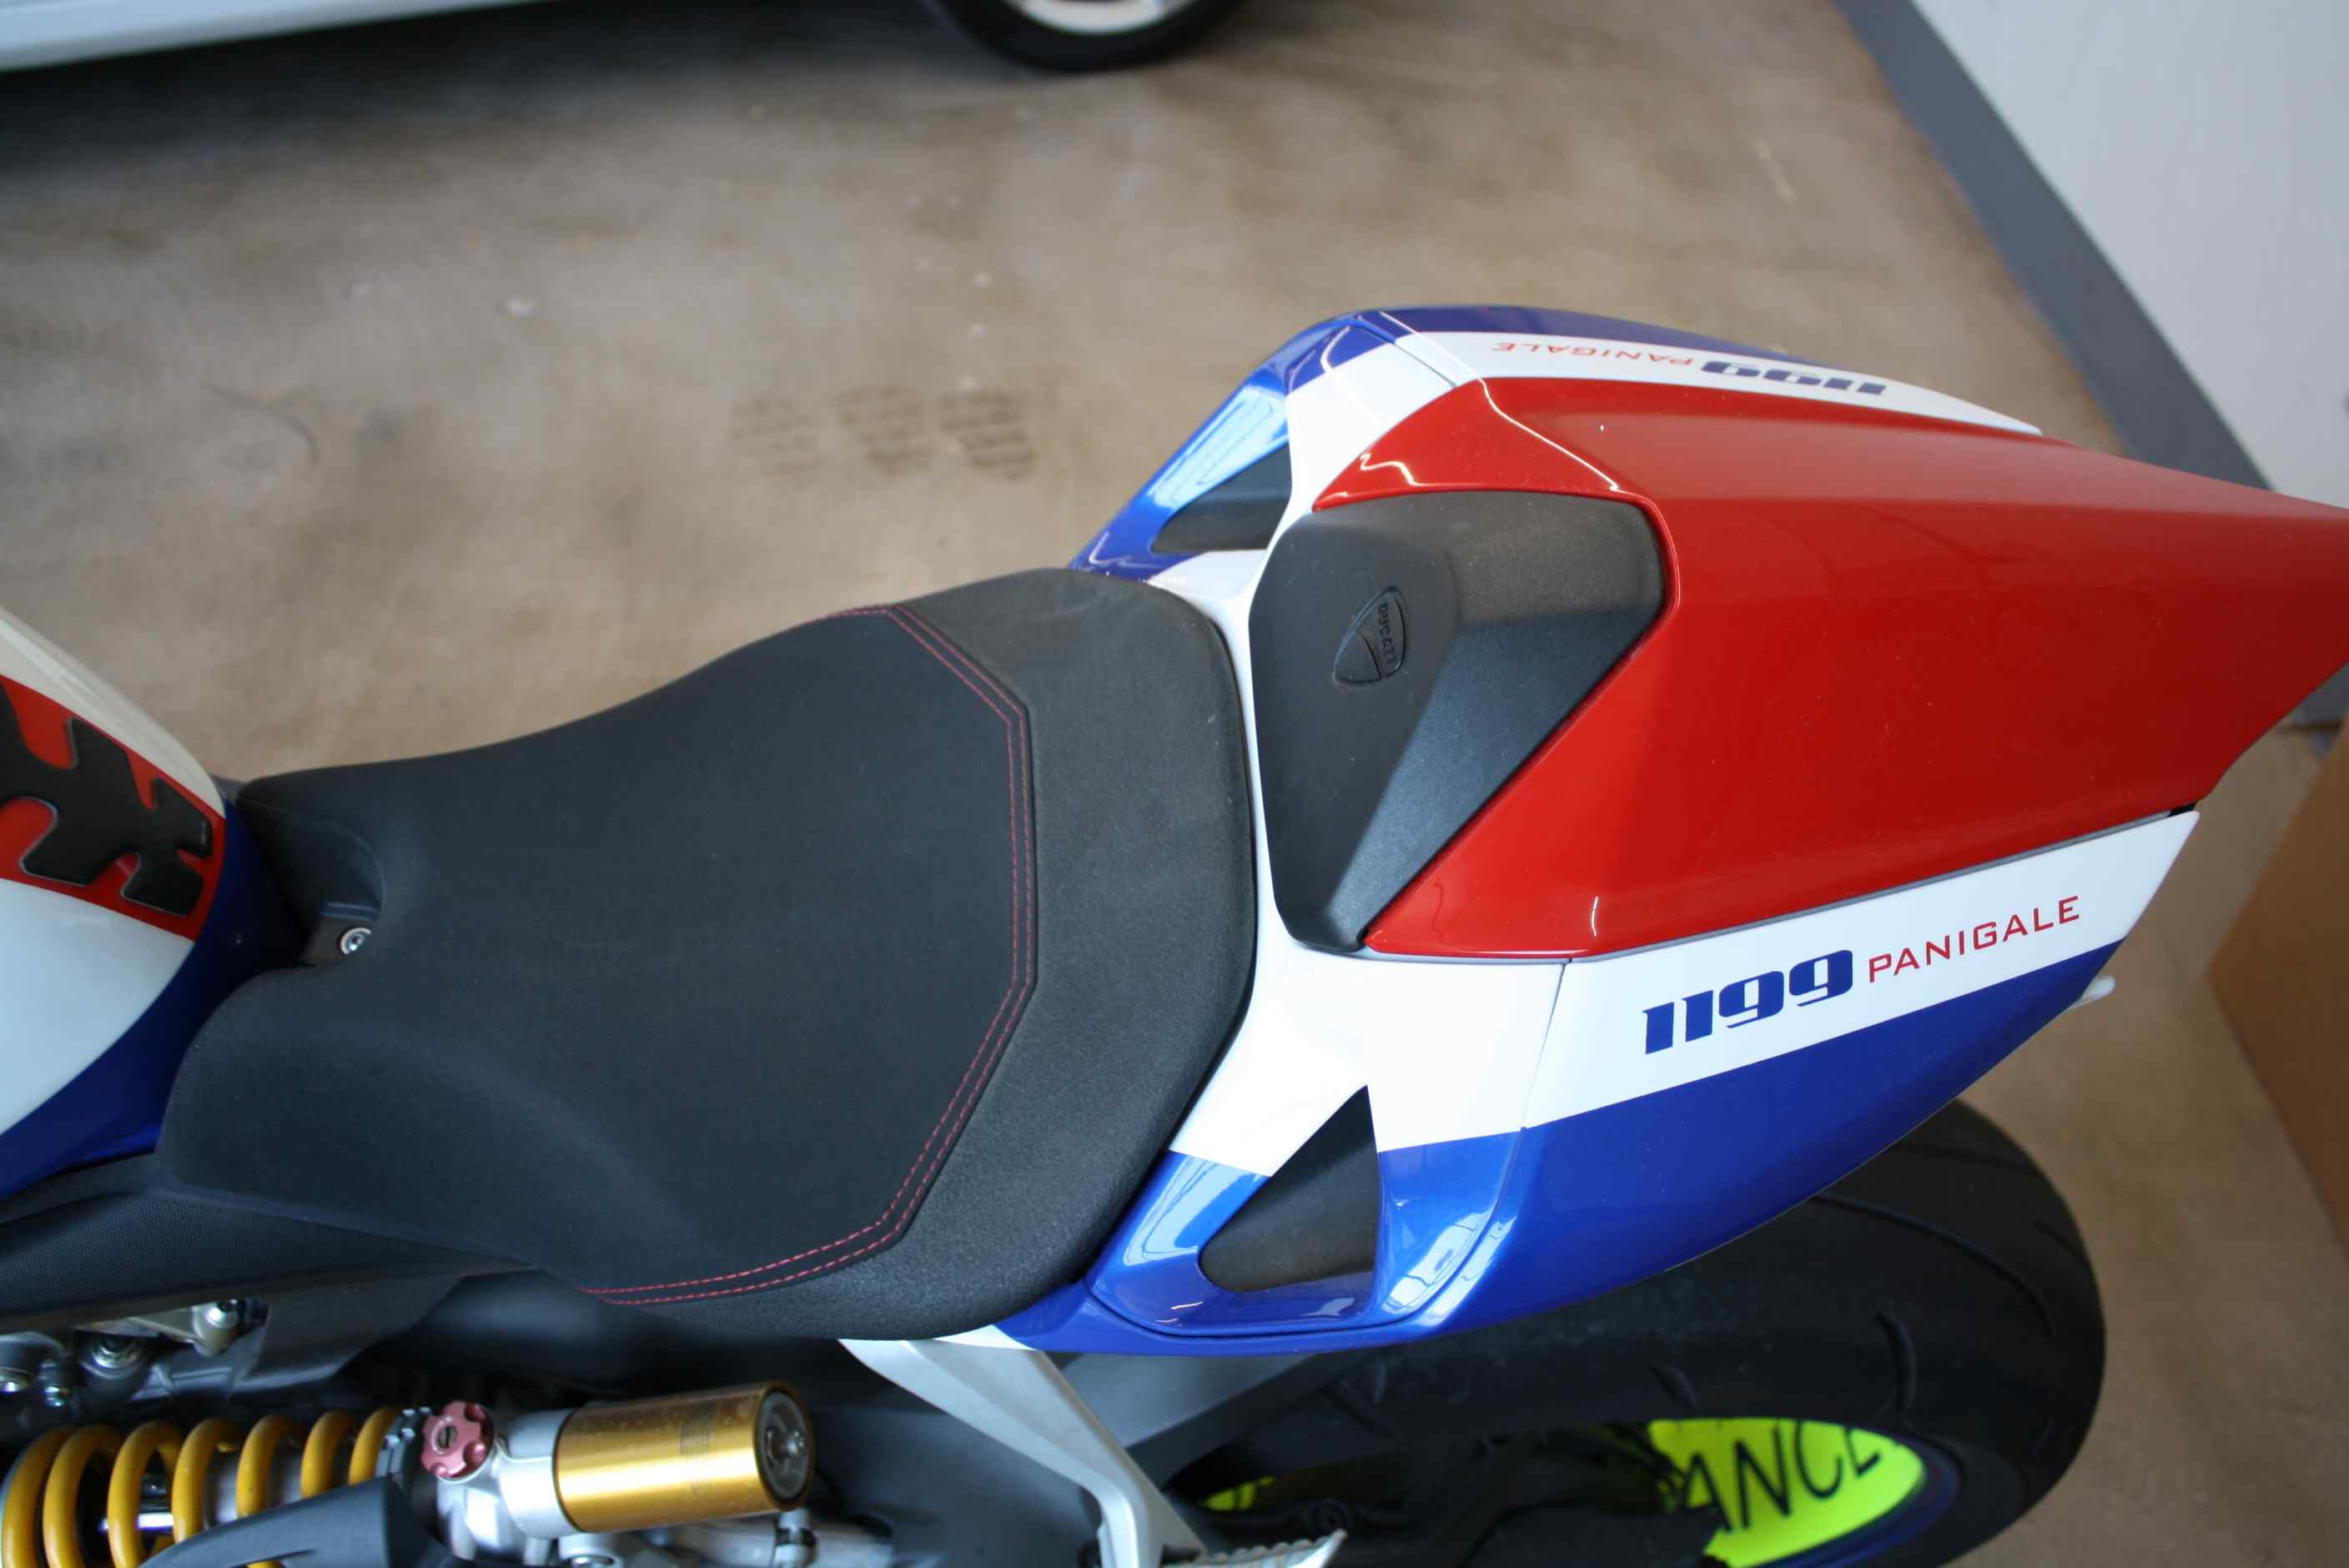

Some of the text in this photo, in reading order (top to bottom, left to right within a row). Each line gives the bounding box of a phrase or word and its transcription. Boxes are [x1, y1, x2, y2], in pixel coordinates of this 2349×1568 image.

[1492, 341, 1693, 366] PANIGALE
[1642, 895, 2081, 1055] 1199 PANIGALE
